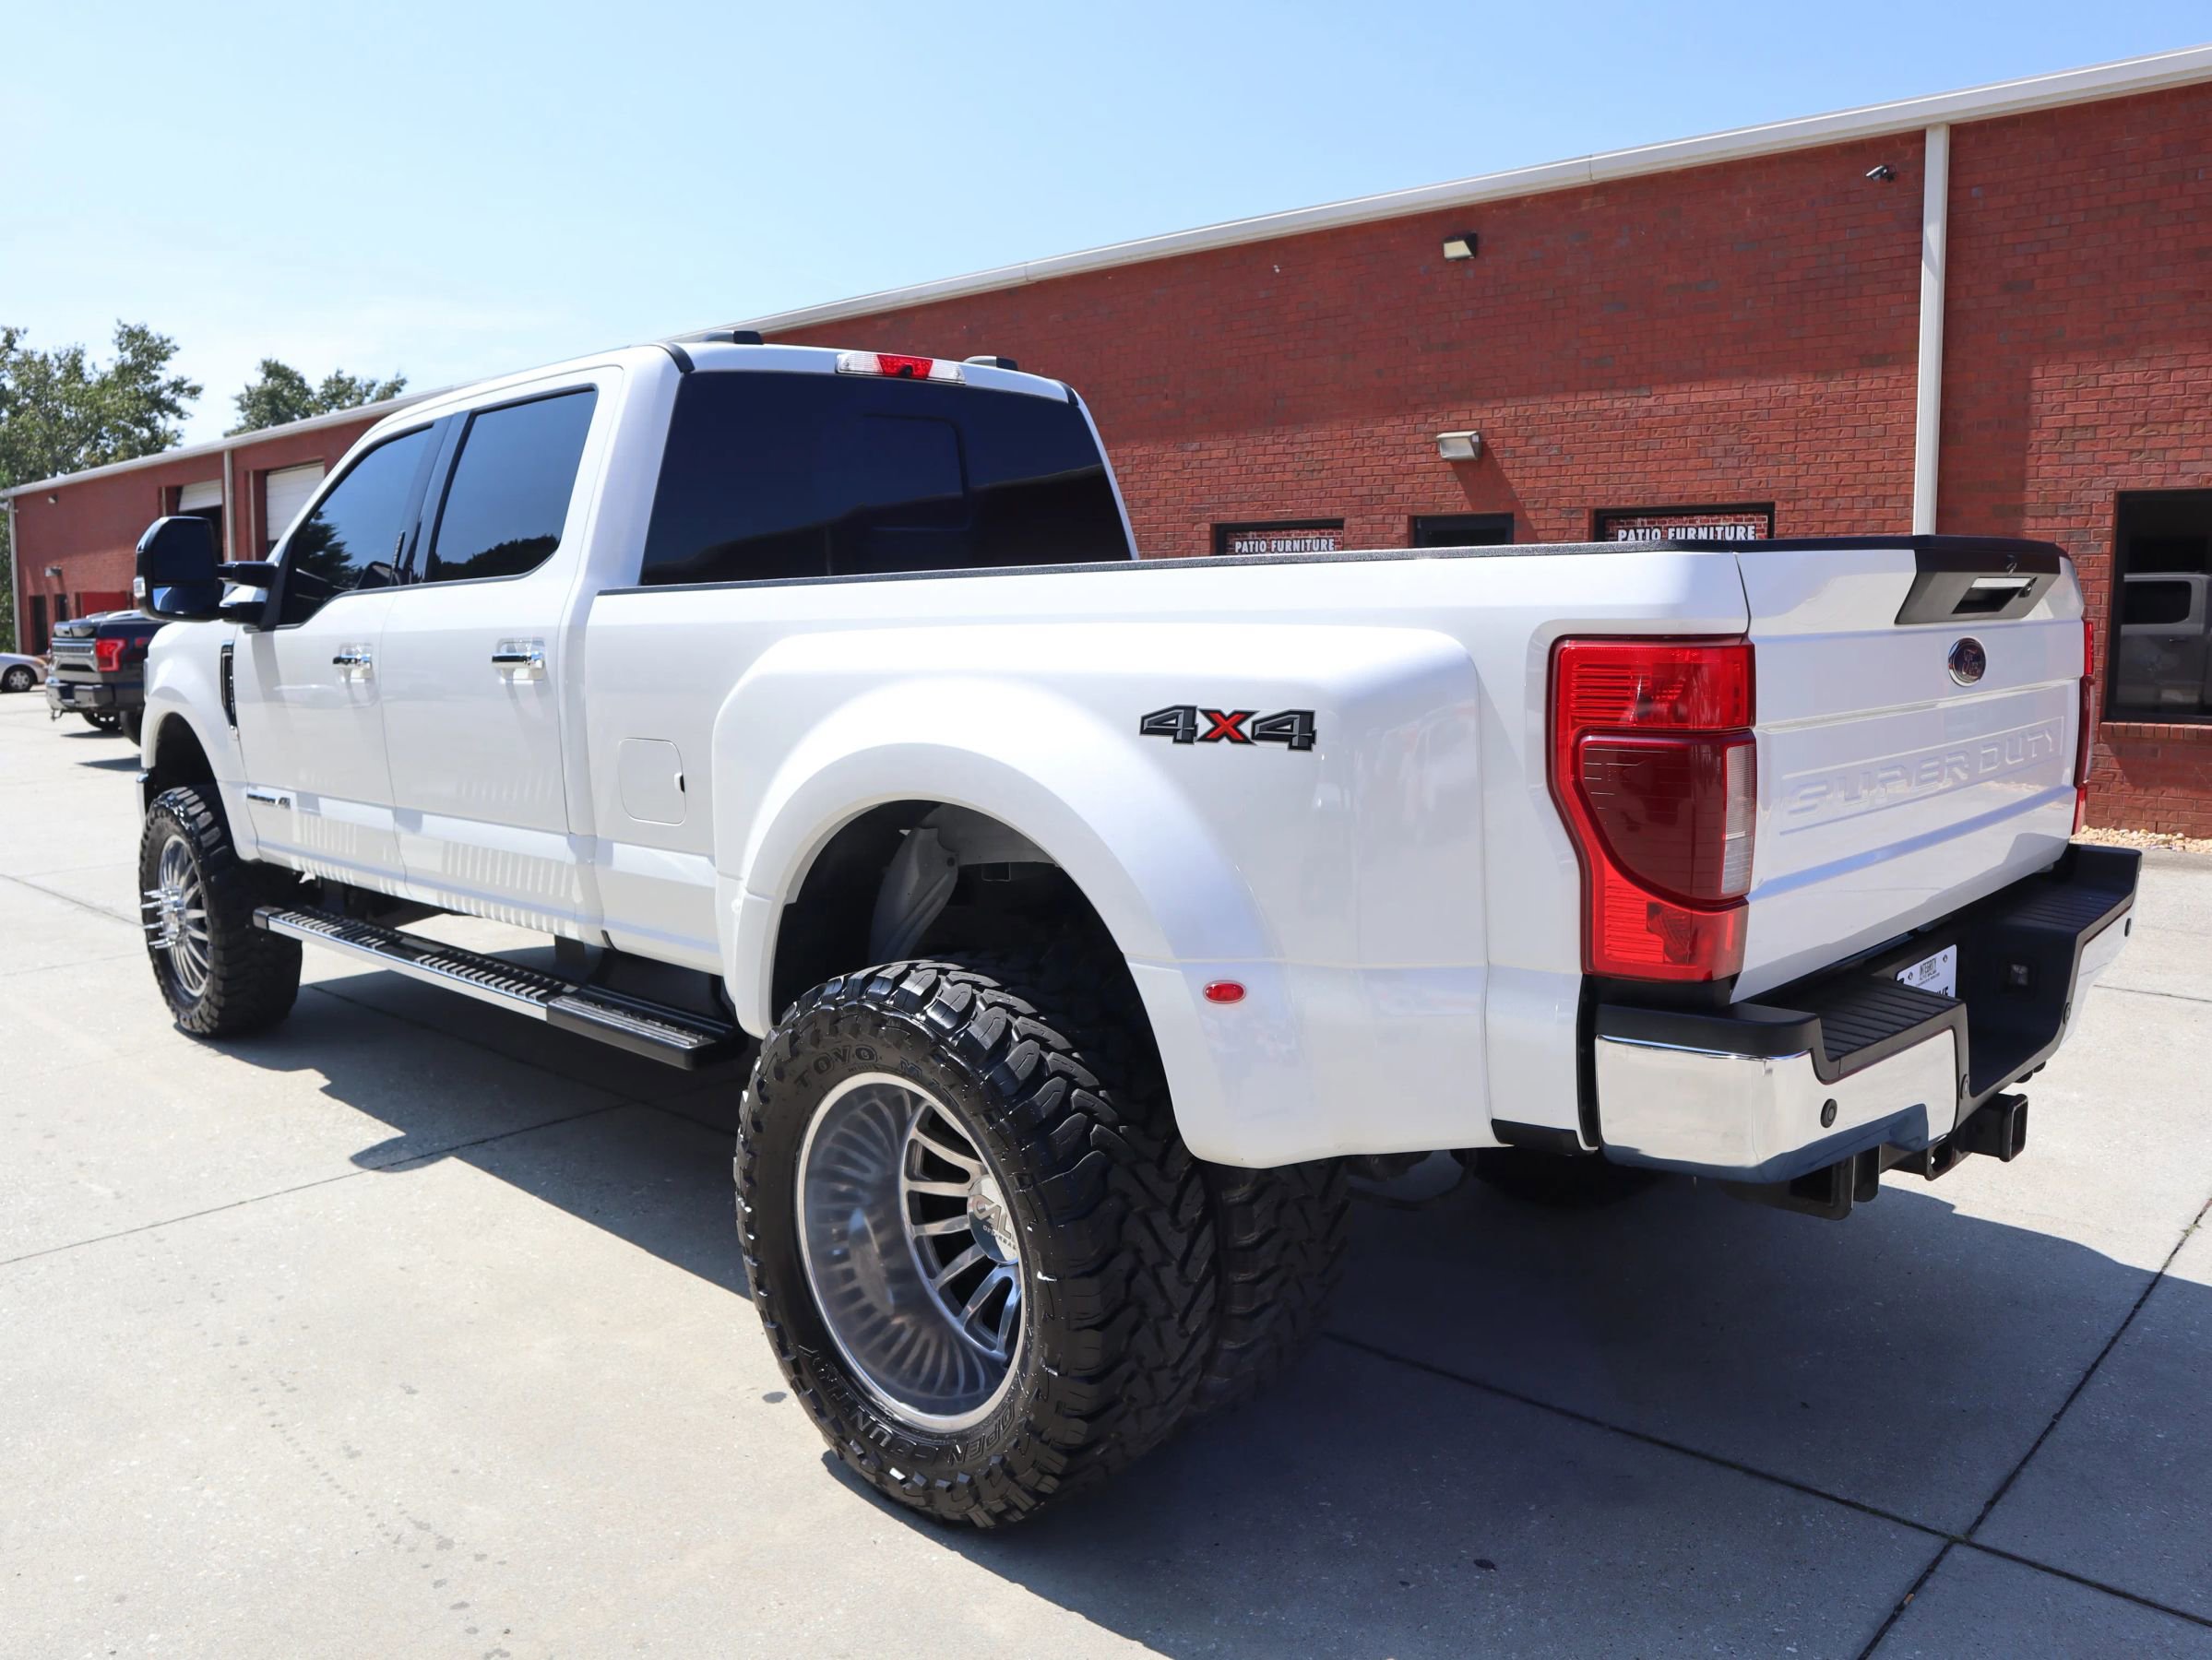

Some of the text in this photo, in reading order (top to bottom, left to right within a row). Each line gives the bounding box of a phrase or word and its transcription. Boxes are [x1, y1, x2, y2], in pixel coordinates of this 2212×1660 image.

[1235, 539, 1335, 553] PATIO FURNITURE
[1617, 526, 1755, 541] PATIO FURNITURE
[1790, 729, 2053, 816] SUPER DUTY
[793, 1043, 880, 1091] TOYO
[972, 1194, 1013, 1239] CAL
[945, 1401, 1016, 1466] OPEN
